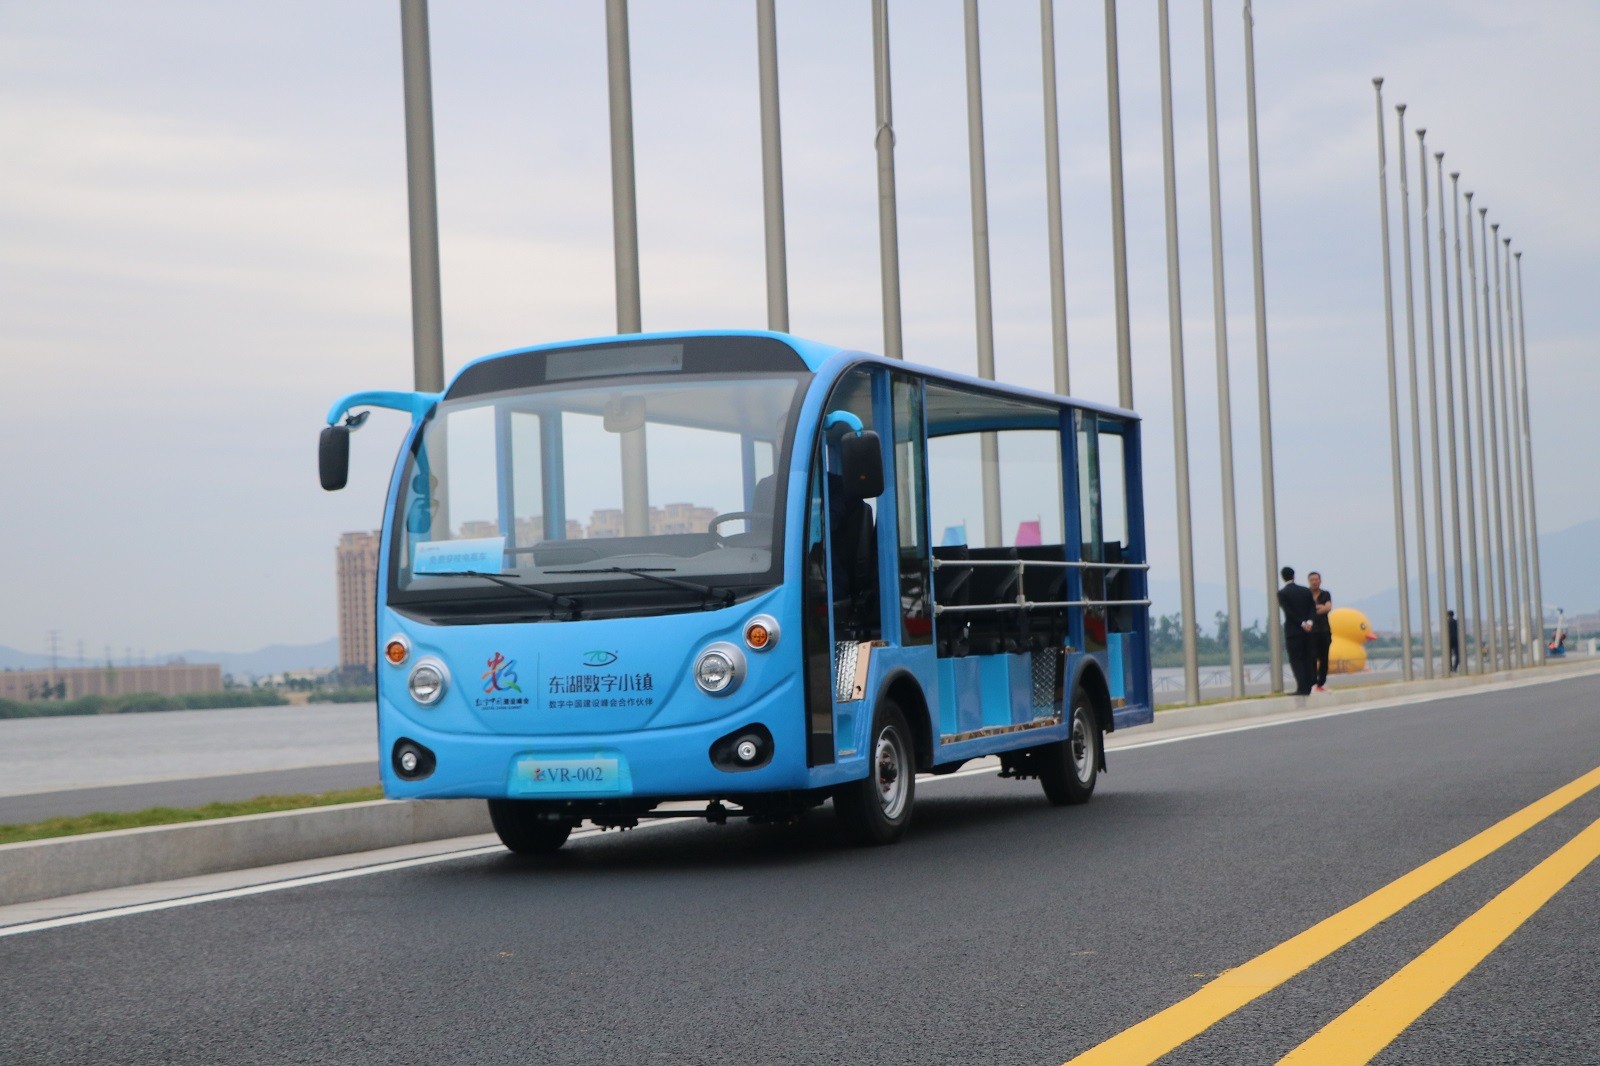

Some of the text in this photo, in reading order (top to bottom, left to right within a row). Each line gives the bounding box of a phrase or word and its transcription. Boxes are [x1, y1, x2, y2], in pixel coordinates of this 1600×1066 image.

[549, 673, 653, 693] 东湖数字小镇
[549, 698, 653, 709] 数字中国建设峰会合作伙伴
[547, 766, 603, 782] VR-002
